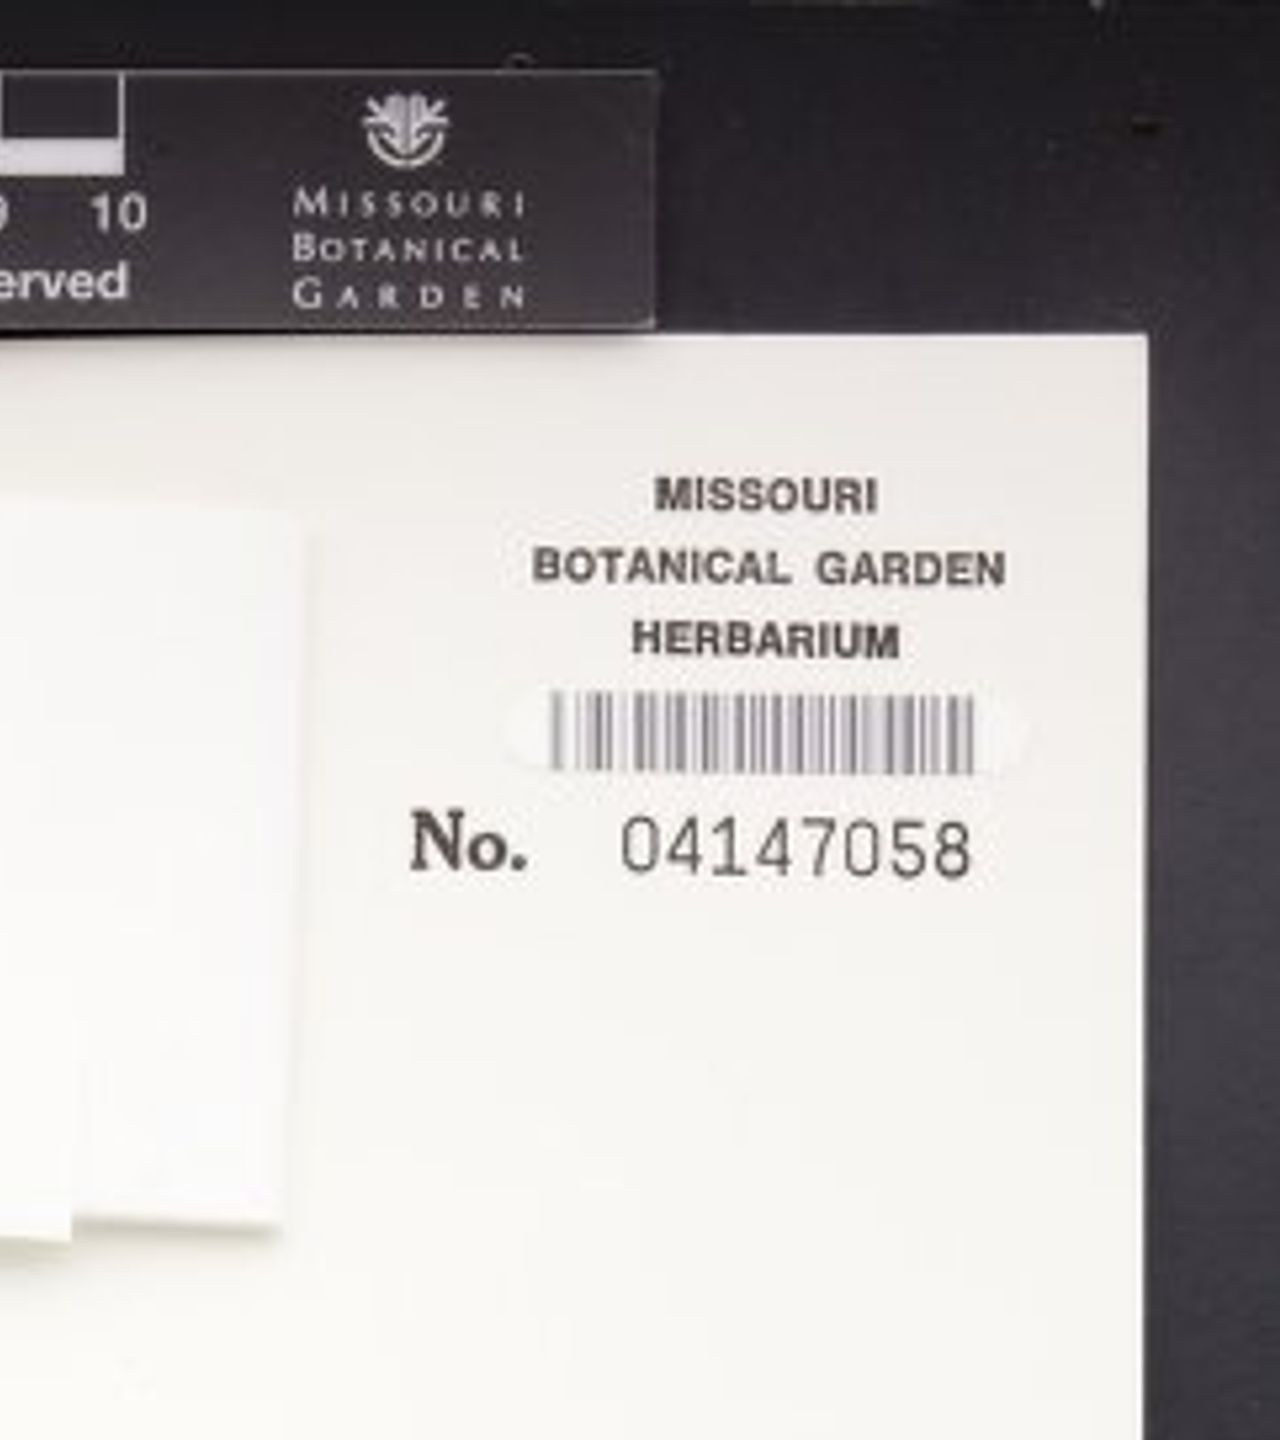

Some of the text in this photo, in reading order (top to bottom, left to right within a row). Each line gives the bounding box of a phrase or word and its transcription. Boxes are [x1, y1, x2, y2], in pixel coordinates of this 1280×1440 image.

[90, 193, 147, 233] 10
[292, 185, 525, 218] MISSOURI
[292, 231, 524, 263] BOTANICAL
[292, 276, 525, 309] GARDEN
[653, 477, 878, 514] MISSOURI
[531, 546, 1007, 587] BOTANICAL GARDEN
[631, 620, 901, 659] HERBARIUM
[410, 807, 972, 879] No. 04147058
